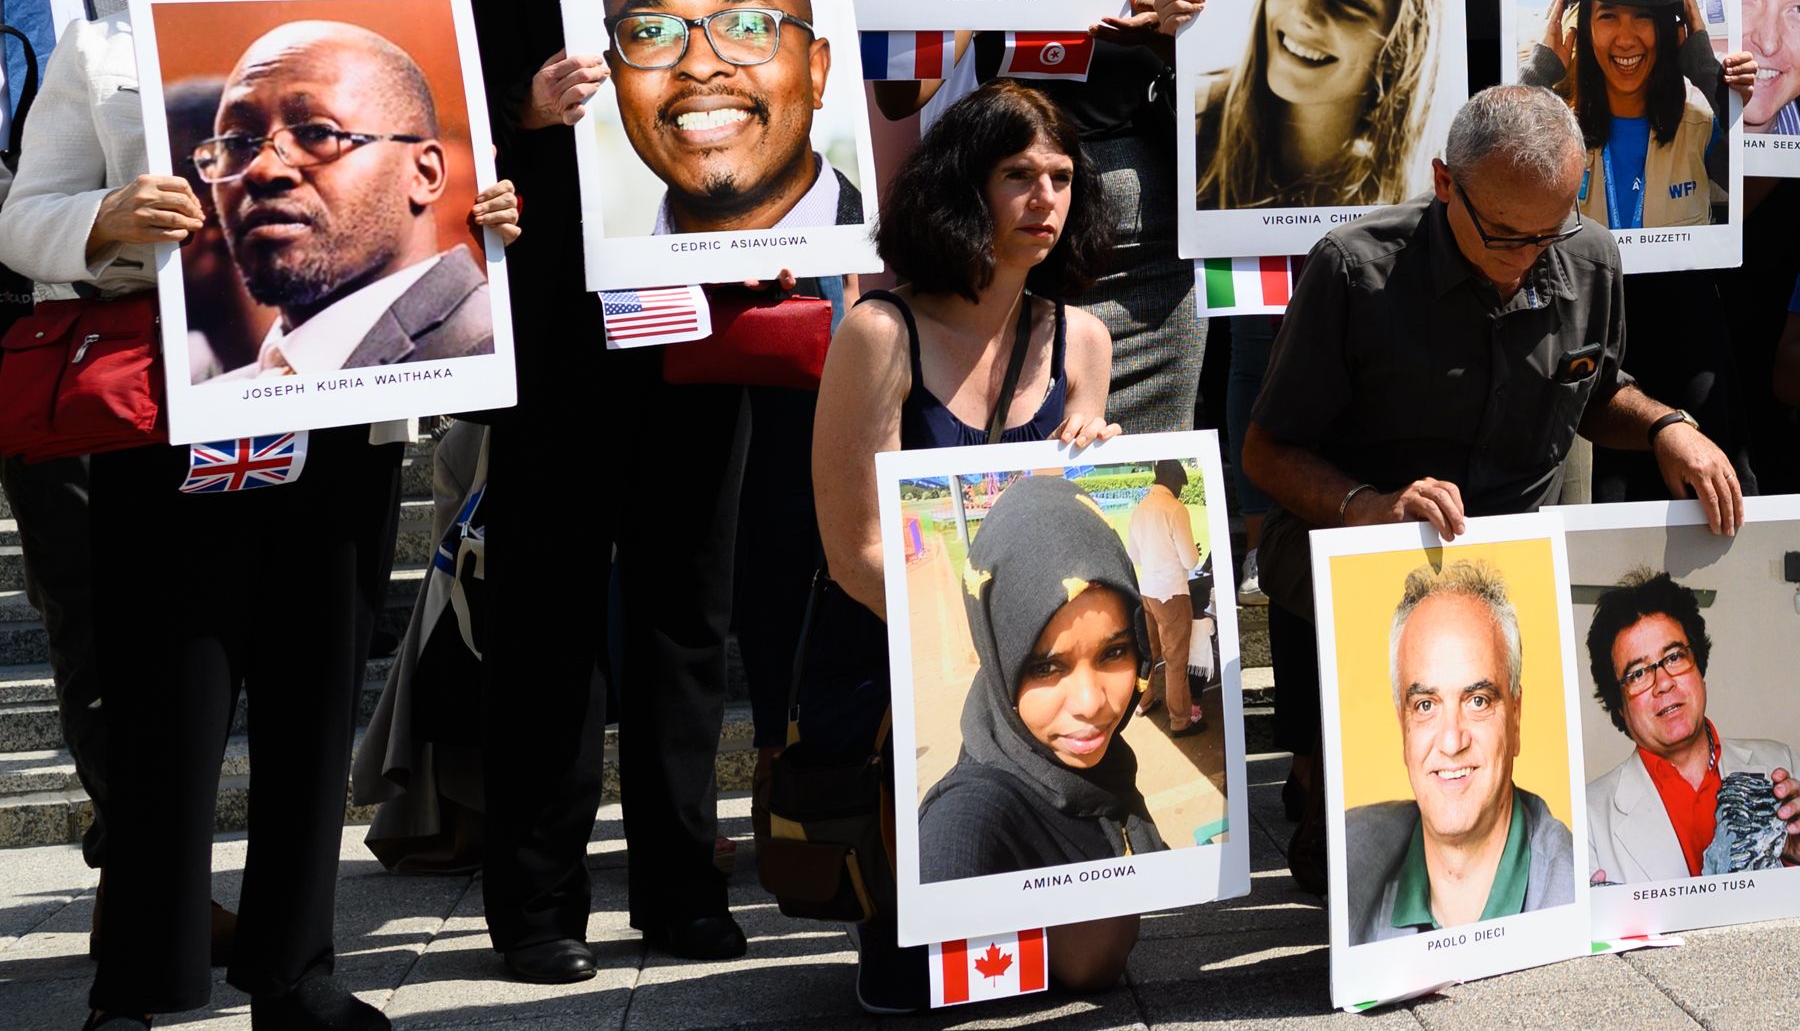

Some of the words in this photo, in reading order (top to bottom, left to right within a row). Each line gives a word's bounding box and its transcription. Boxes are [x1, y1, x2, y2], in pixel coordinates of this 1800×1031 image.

[1773, 141, 1800, 150] SEEX
[1262, 214, 1322, 225] VIRGINIA
[671, 239, 722, 253] CEDRIC
[731, 235, 808, 250] ASIAVUGWA
[1640, 233, 1691, 244] BUZZETTI
[242, 382, 306, 401] JOSEPH
[316, 376, 365, 393] KURIA
[374, 367, 454, 386] WAITHAKA
[1023, 872, 1073, 891] AMINA
[1078, 864, 1136, 883] ODOWA
[1632, 881, 1718, 901] SEBASTIANO
[1721, 877, 1756, 890] TUSA
[1427, 933, 1467, 951] PAOLO
[1474, 927, 1506, 943] DIECI
